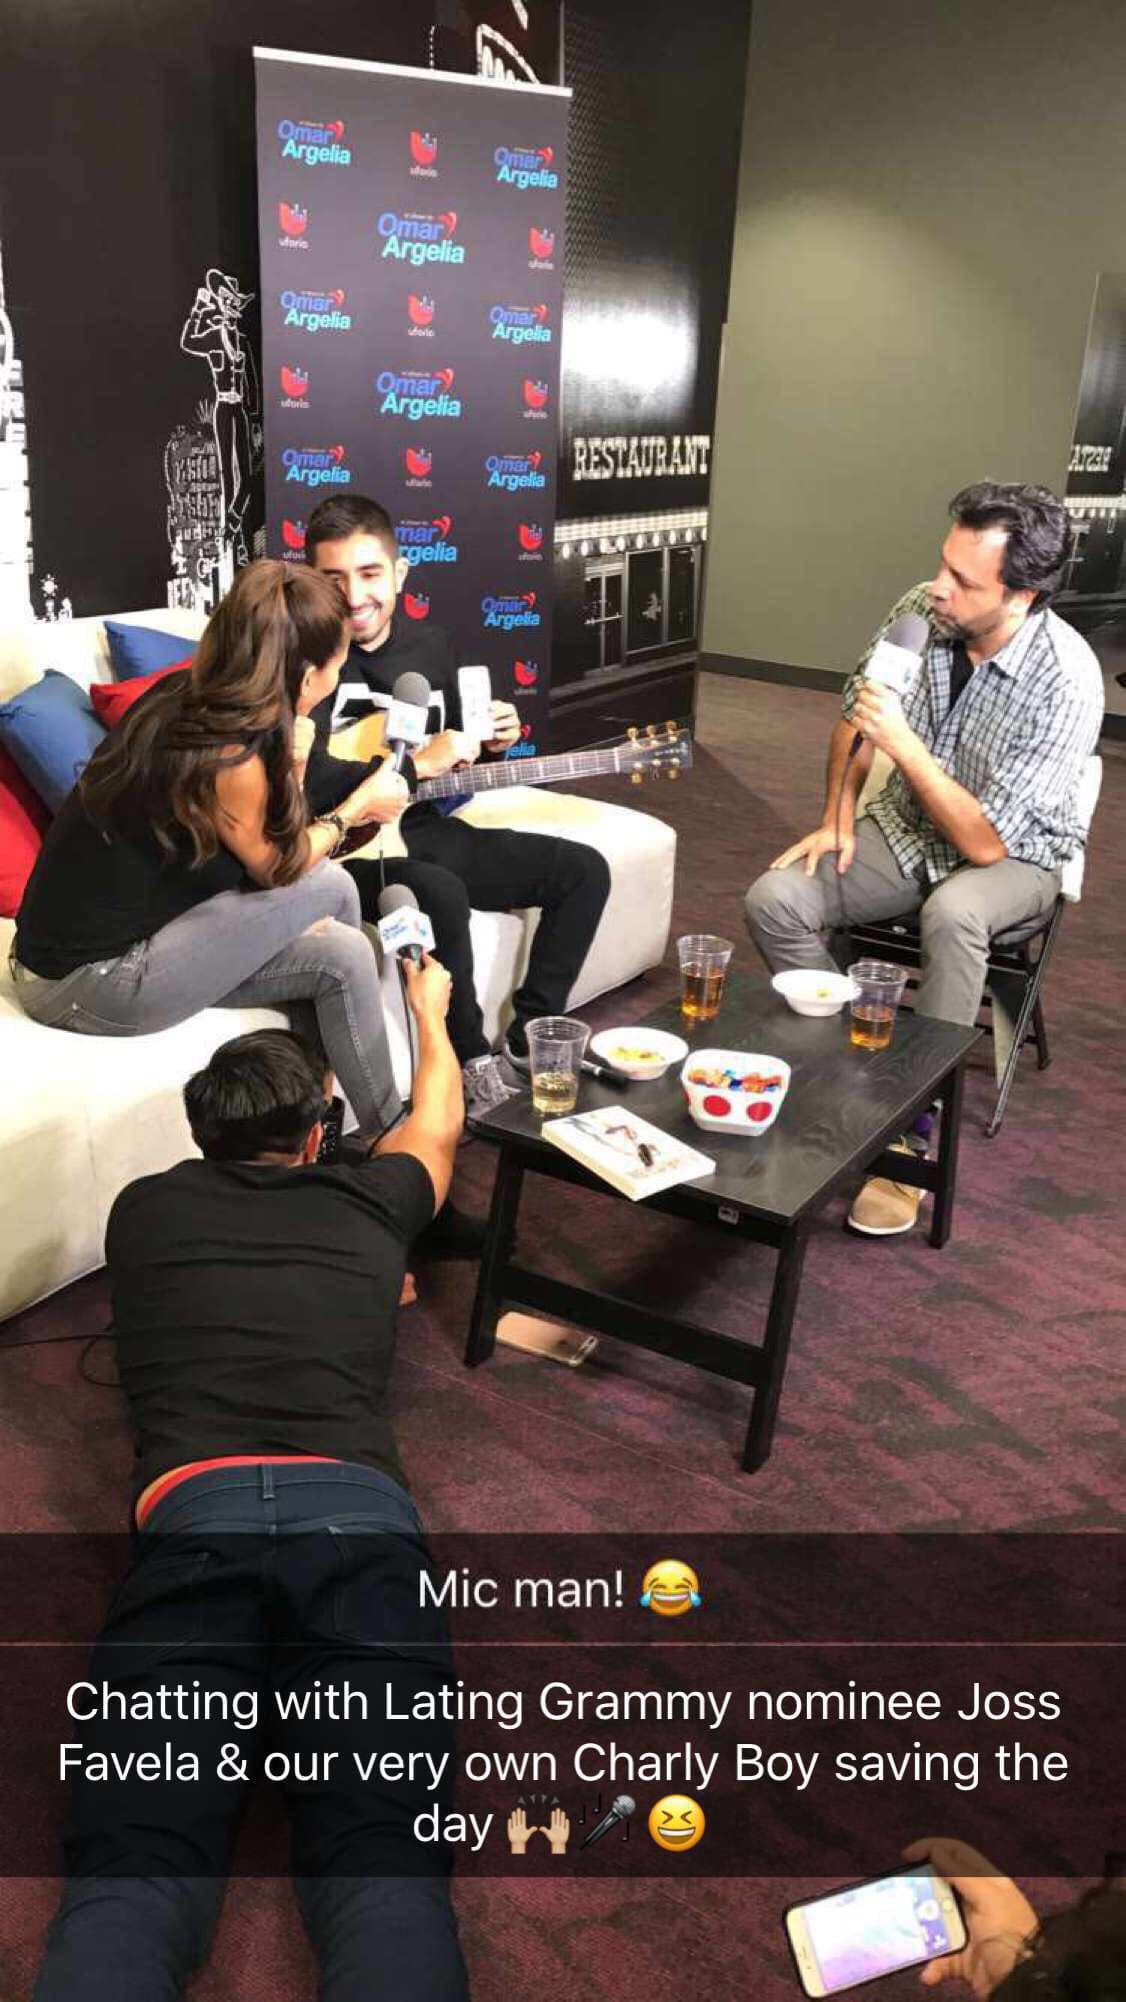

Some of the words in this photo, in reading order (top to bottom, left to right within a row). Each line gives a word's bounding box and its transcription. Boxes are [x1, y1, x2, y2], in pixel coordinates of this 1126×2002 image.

[277, 119, 334, 144] Omar
[281, 139, 351, 165] Argelia
[493, 147, 543, 169] Omar
[496, 165, 559, 189] Argelia
[377, 212, 444, 241] Omar
[382, 235, 465, 266] Argelia
[280, 290, 333, 312] Omar
[284, 308, 351, 332] Argelia
[489, 305, 538, 325] Omar
[491, 321, 552, 344] Argelia
[376, 371, 441, 397] Omar
[380, 392, 462, 420] Argelia
[282, 448, 334, 467] Omar
[485, 454, 531, 473] Omar
[573, 434, 710, 481] RESTAURANT
[286, 464, 351, 486] Argelia
[487, 470, 546, 491] Argelia
[394, 526, 439, 543] mar
[399, 541, 458, 567] rgelia
[481, 596, 528, 614] Omar
[483, 611, 541, 630] Argelia
